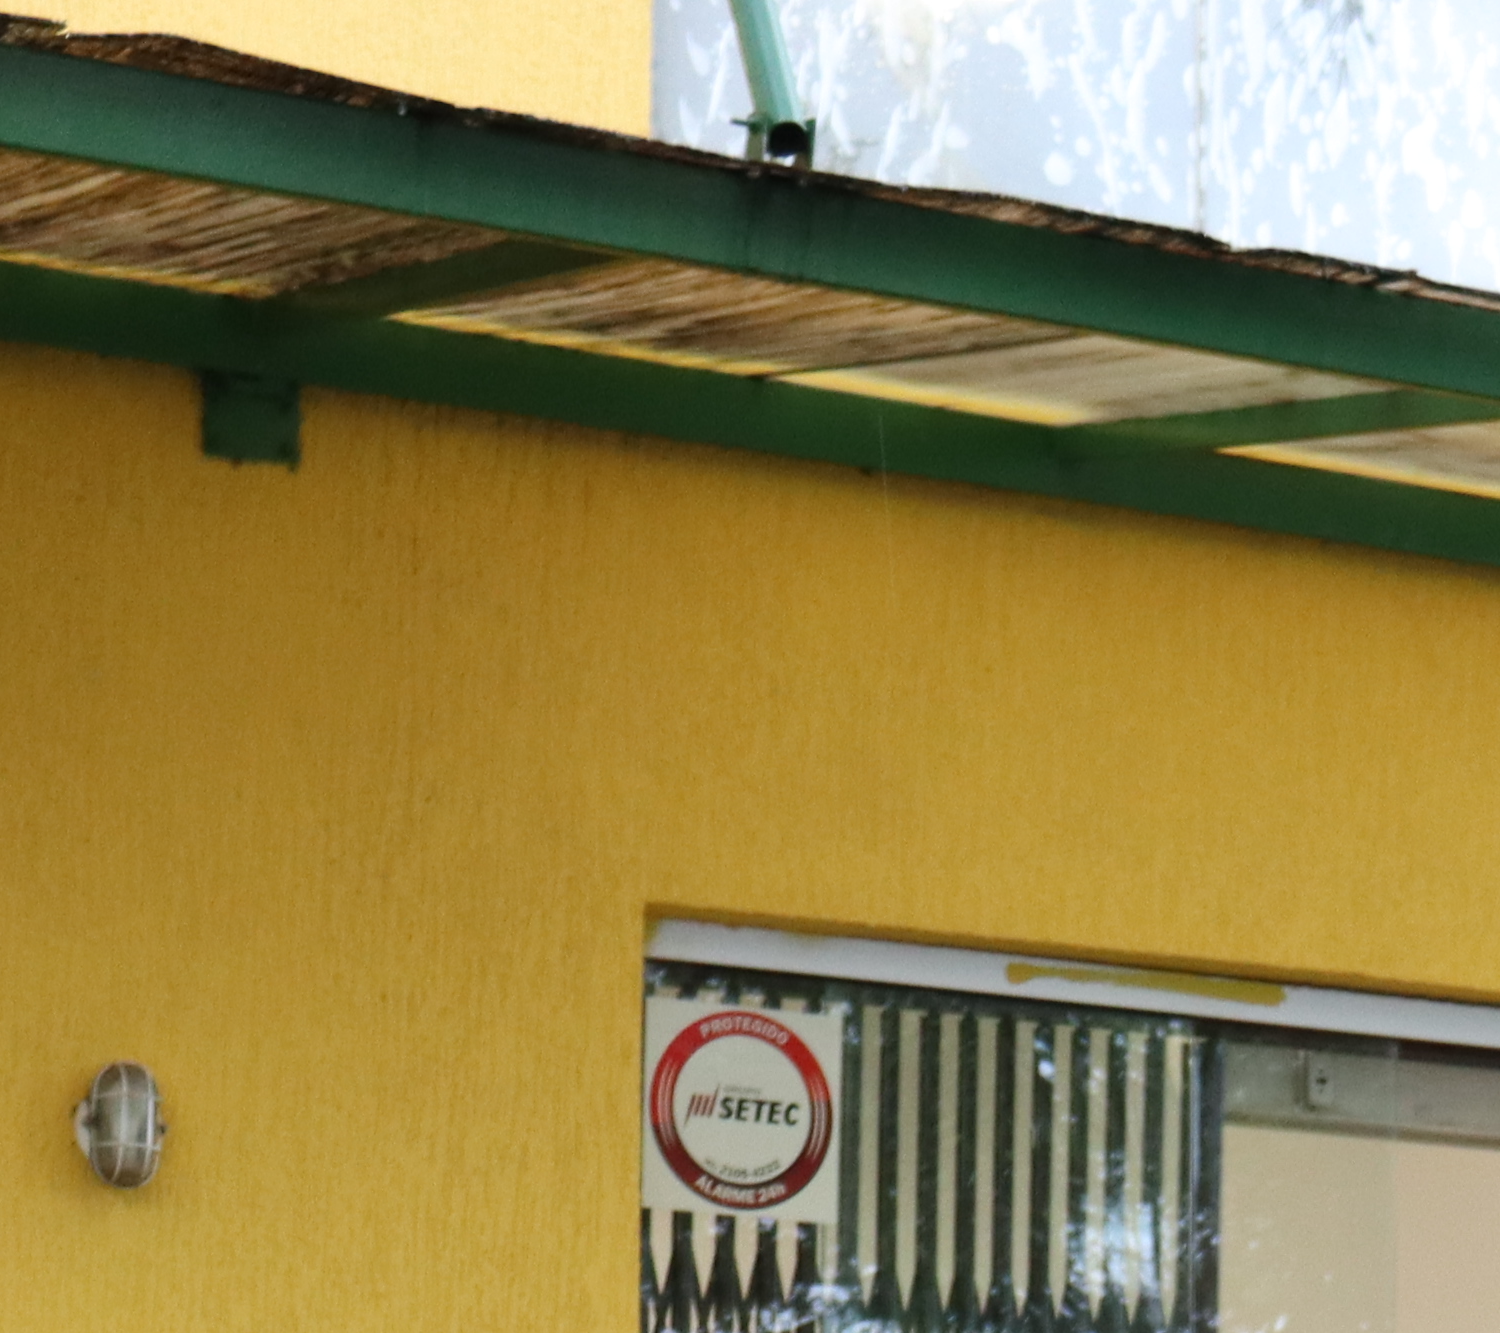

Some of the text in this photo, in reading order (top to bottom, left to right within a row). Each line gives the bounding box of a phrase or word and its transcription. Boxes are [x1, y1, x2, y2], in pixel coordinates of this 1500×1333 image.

[700, 1016, 789, 1044] PROTEGIDO
[720, 1097, 799, 1126] SETEC
[695, 1175, 755, 1203] ALARME
